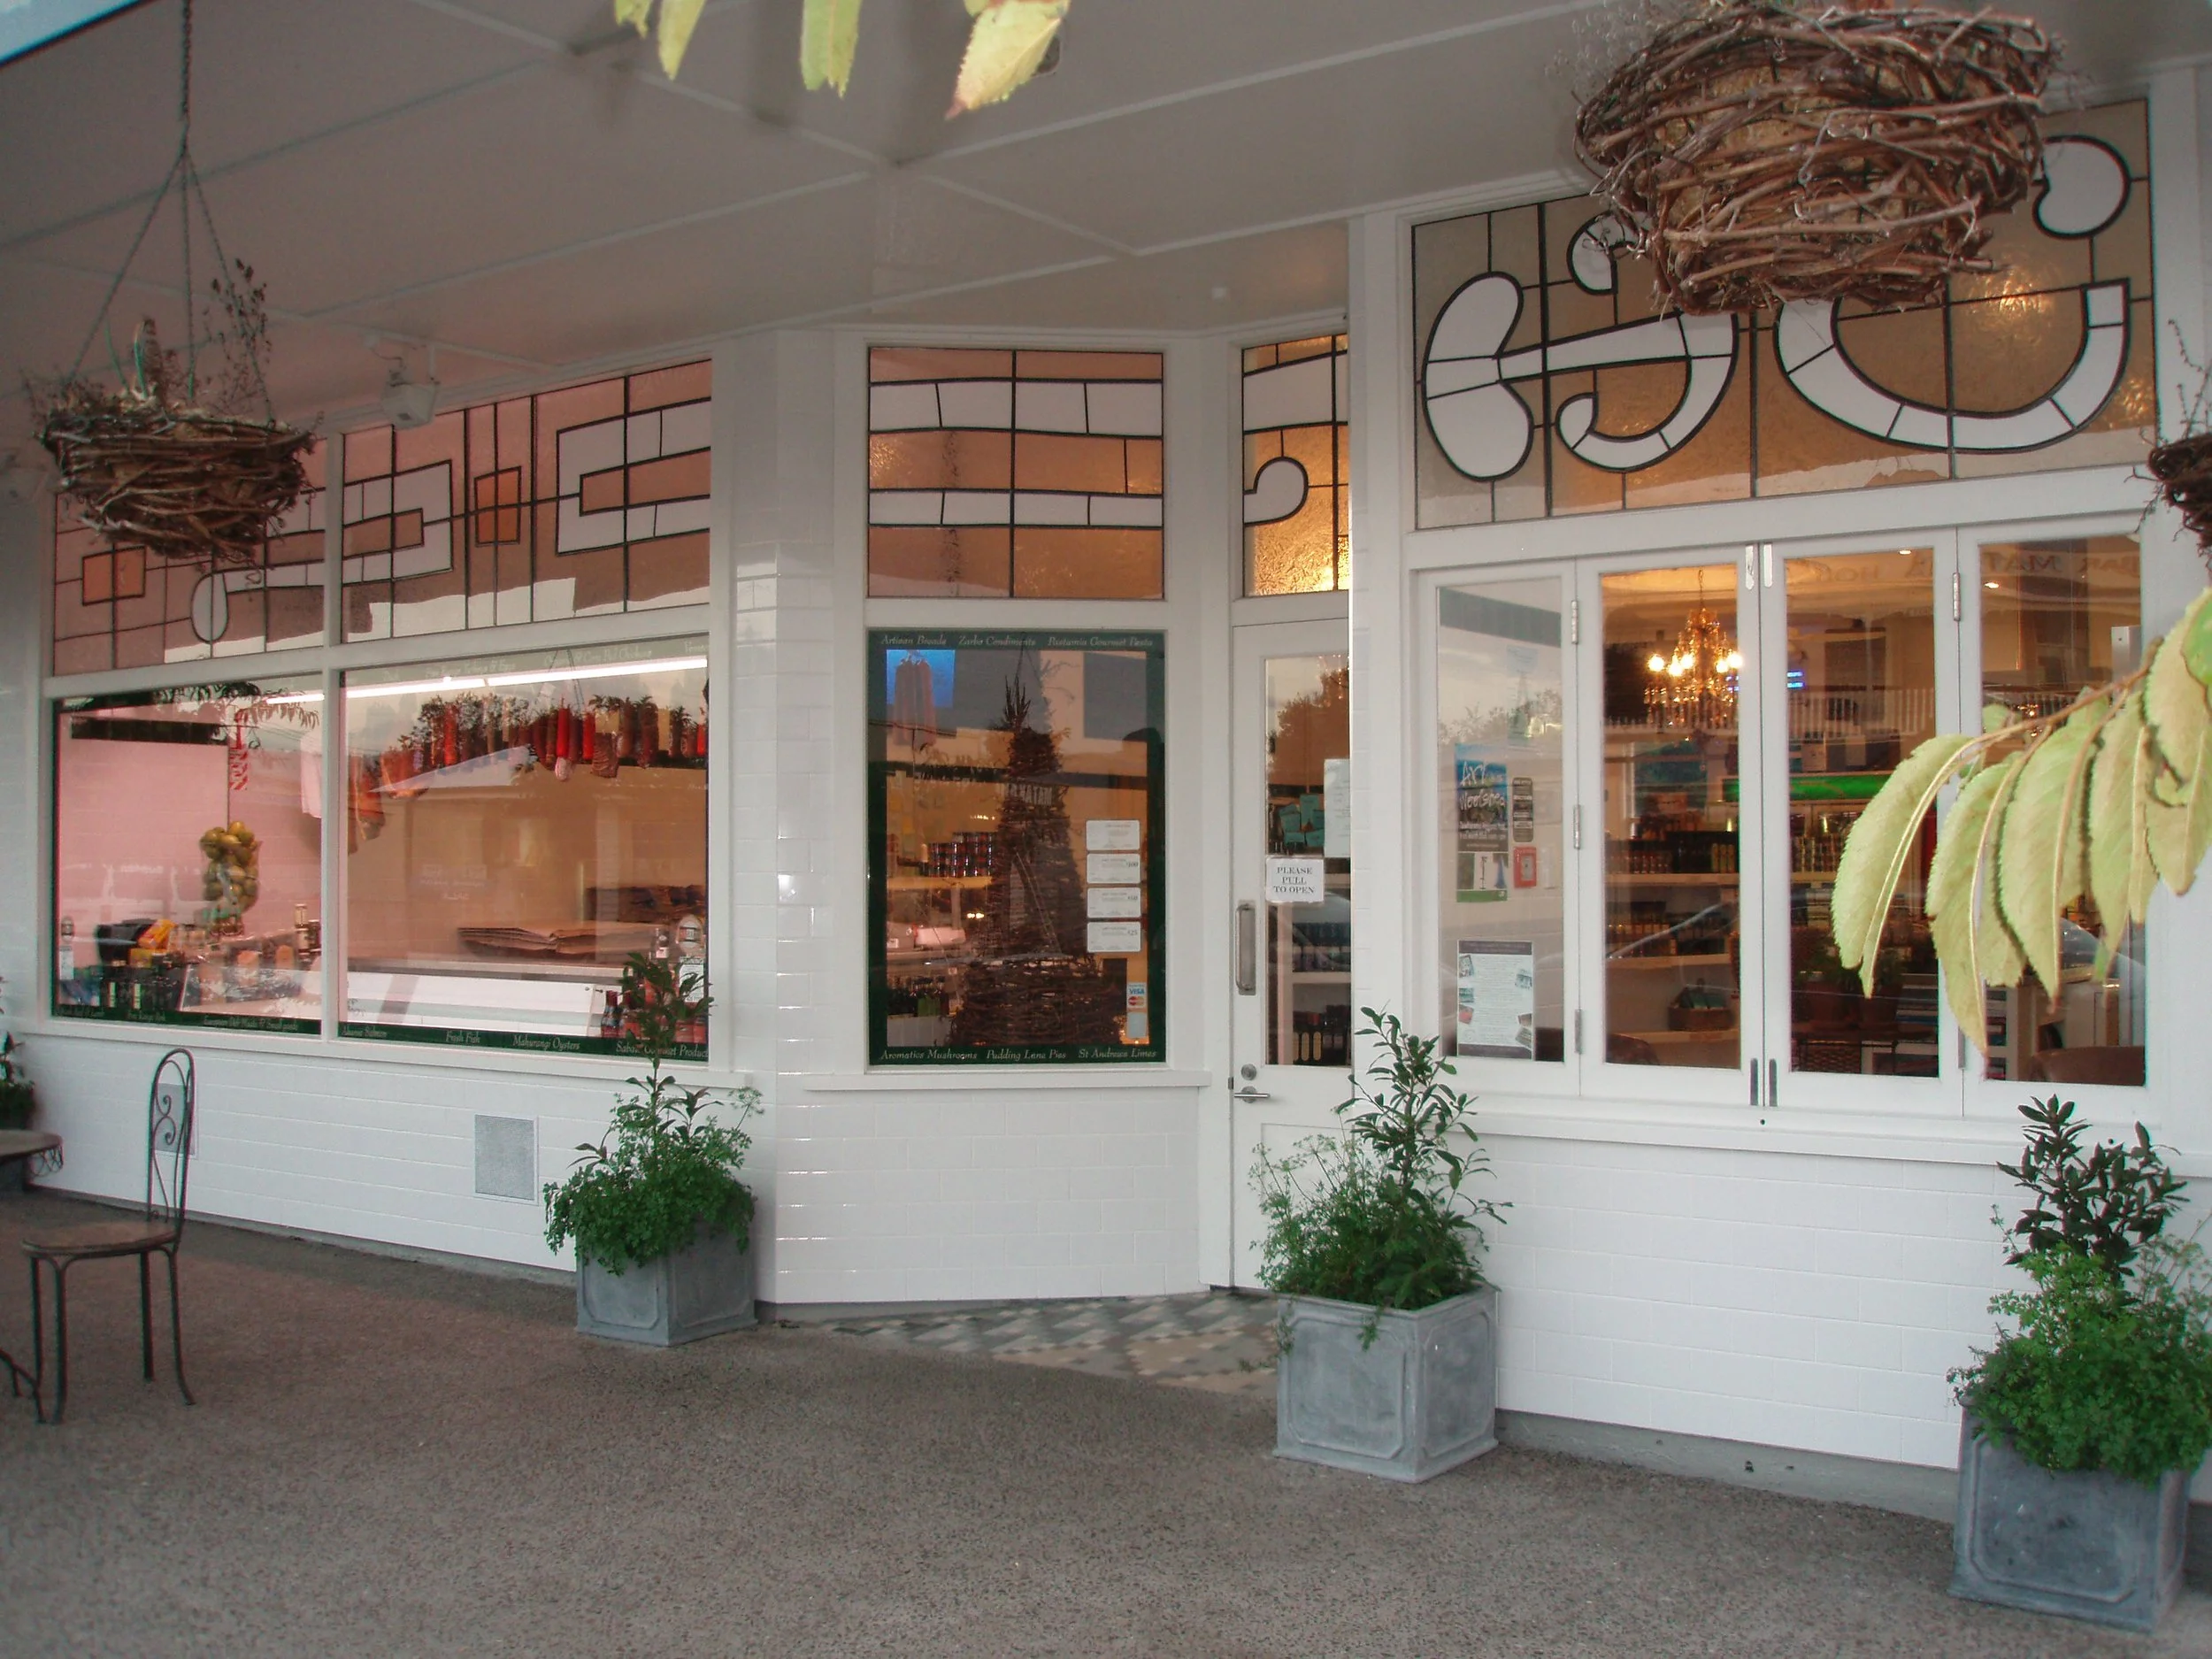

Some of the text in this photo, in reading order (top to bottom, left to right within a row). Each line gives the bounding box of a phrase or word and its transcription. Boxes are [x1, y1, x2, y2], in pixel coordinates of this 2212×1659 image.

[881, 634, 948, 646] Artisan Breads
[1089, 636, 1126, 647] Gourmet
[1277, 866, 1313, 875] PLEASE
[1282, 876, 1307, 885] PULL
[1273, 885, 1316, 895] TO OPEN
[465, 1030, 481, 1044] Fish
[552, 1036, 581, 1051] Oysters
[880, 1048, 978, 1060] Aromatics Mushrooms
[986, 1048, 1067, 1062] Pudding Lane Pies
[1078, 1048, 1088, 1059] St
[1131, 1048, 1157, 1058] Limes
